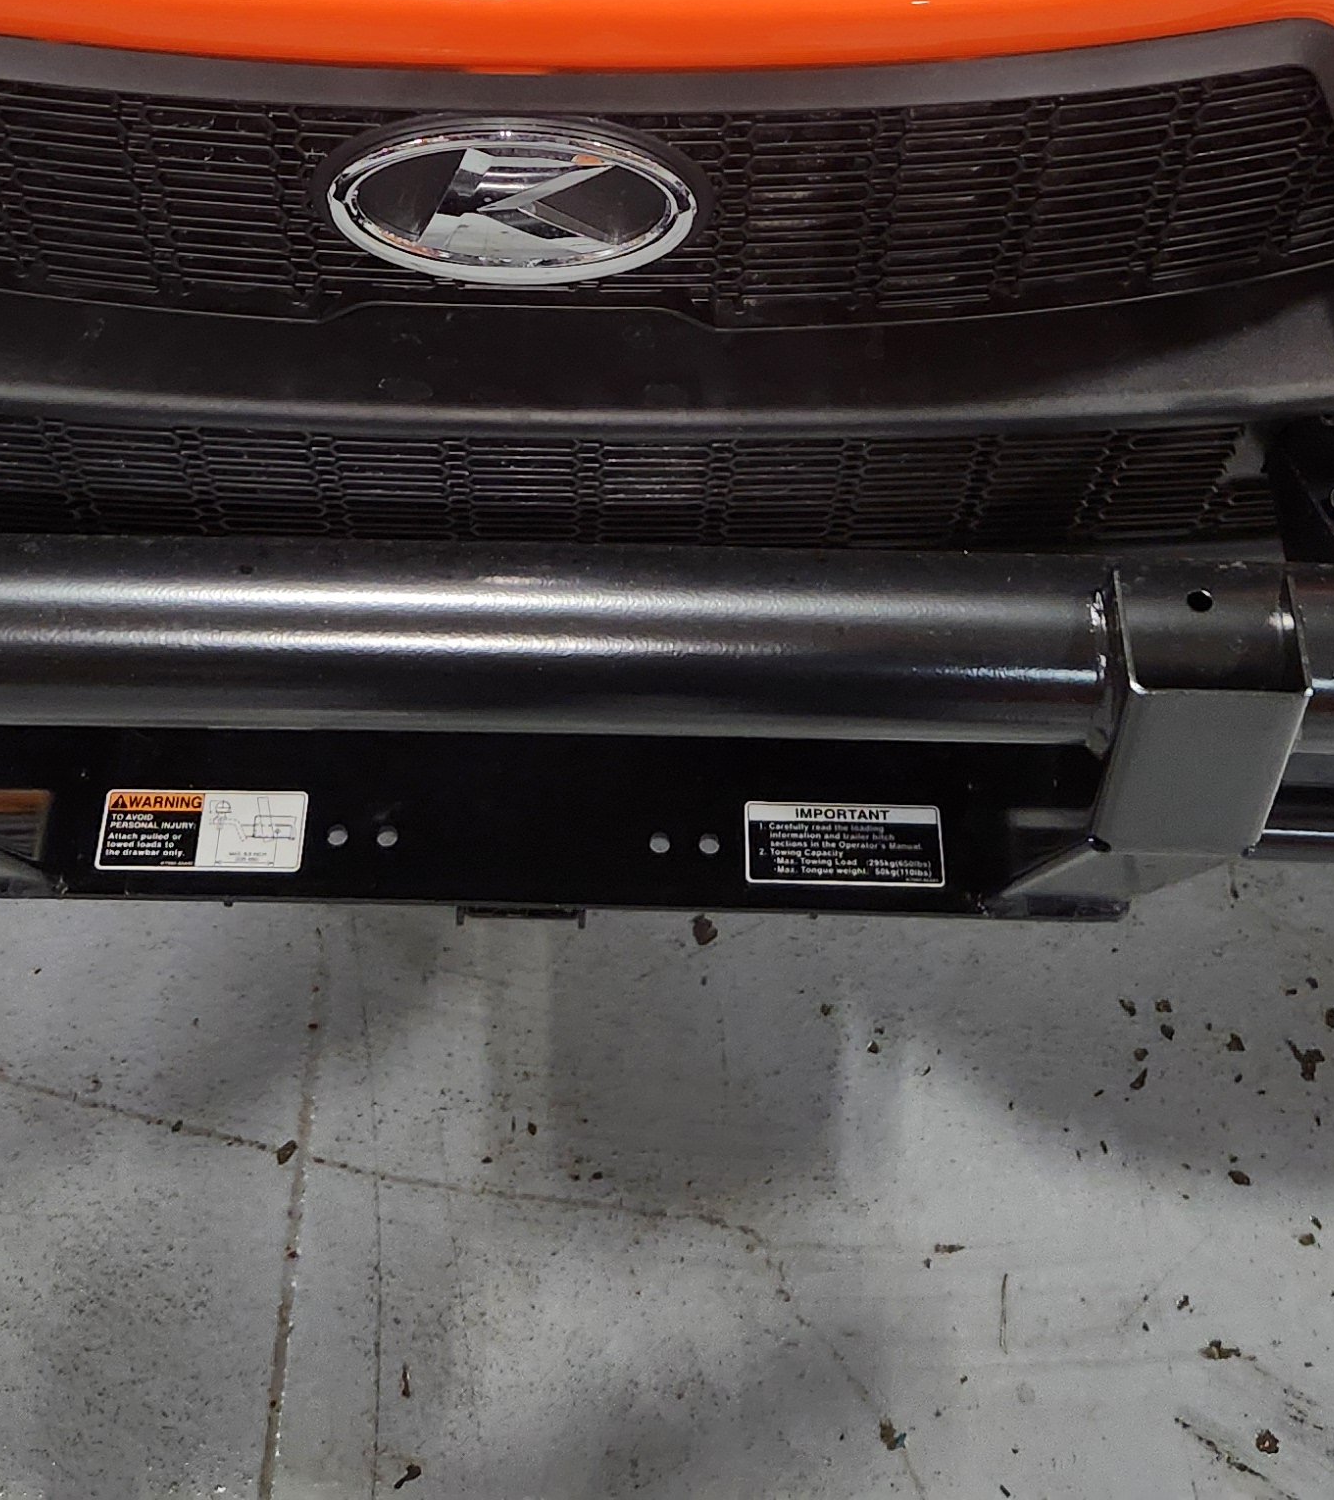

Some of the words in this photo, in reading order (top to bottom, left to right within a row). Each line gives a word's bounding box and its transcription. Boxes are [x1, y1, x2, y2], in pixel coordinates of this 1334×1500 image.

[129, 795, 203, 809] WARNING
[111, 813, 124, 821] TO
[125, 813, 154, 821] AVOID
[795, 808, 890, 821] IMPORTANT
[109, 821, 159, 829] PERSONAL
[768, 822, 809, 832] Carefully
[811, 823, 832, 831] read
[107, 832, 138, 840] Attach
[140, 833, 170, 841] pulled
[769, 831, 821, 839] information
[824, 832, 841, 840] and
[770, 840, 808, 848] sections
[105, 848, 121, 856] the
[122, 848, 160, 856] drawbar
[162, 848, 185, 858] only.
[770, 847, 802, 858] Towing
[804, 848, 844, 859] Capacity
[800, 857, 833, 867] Towing
[834, 858, 858, 866] Load
[801, 865, 834, 876] Tongue
